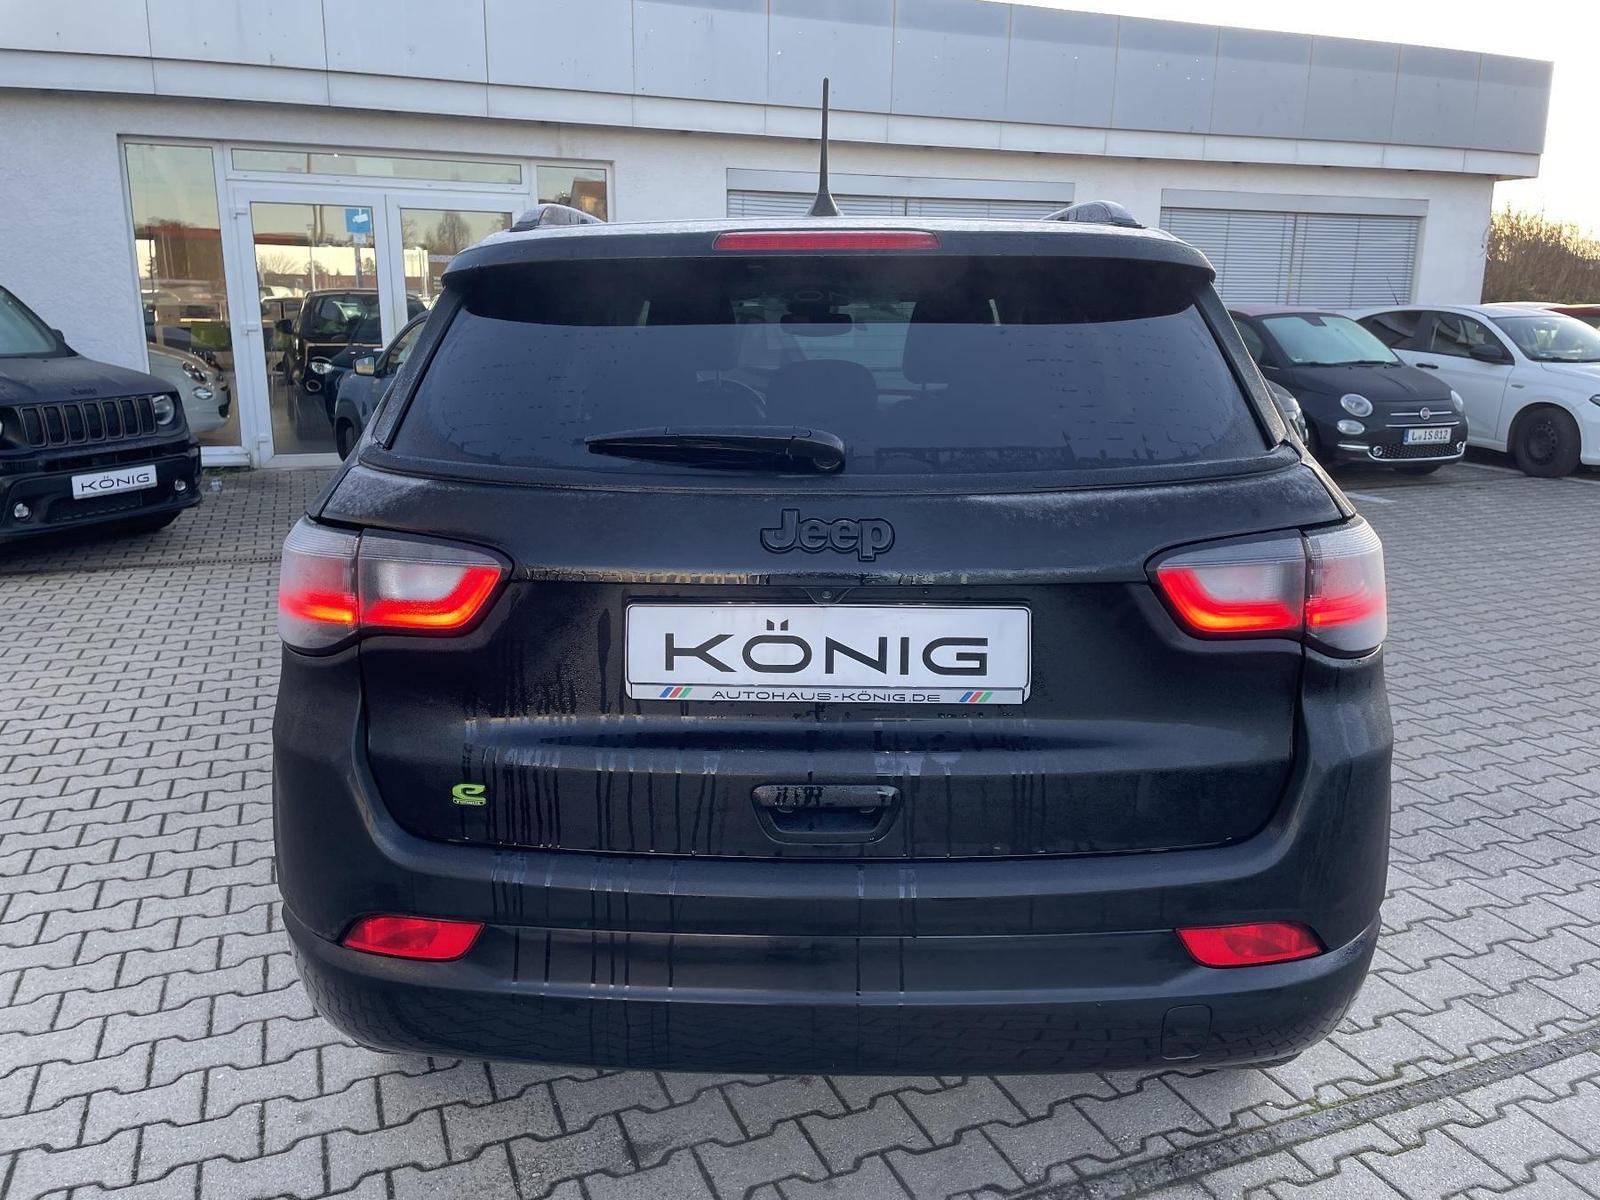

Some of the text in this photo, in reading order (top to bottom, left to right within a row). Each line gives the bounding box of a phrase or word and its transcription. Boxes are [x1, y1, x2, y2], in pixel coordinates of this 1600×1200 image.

[81, 473, 150, 492] KÖNIG
[760, 508, 895, 562] Jeep
[664, 618, 989, 677] KÖNIG
[711, 690, 941, 703] AUTOHAUS-KÖNIG.DE
